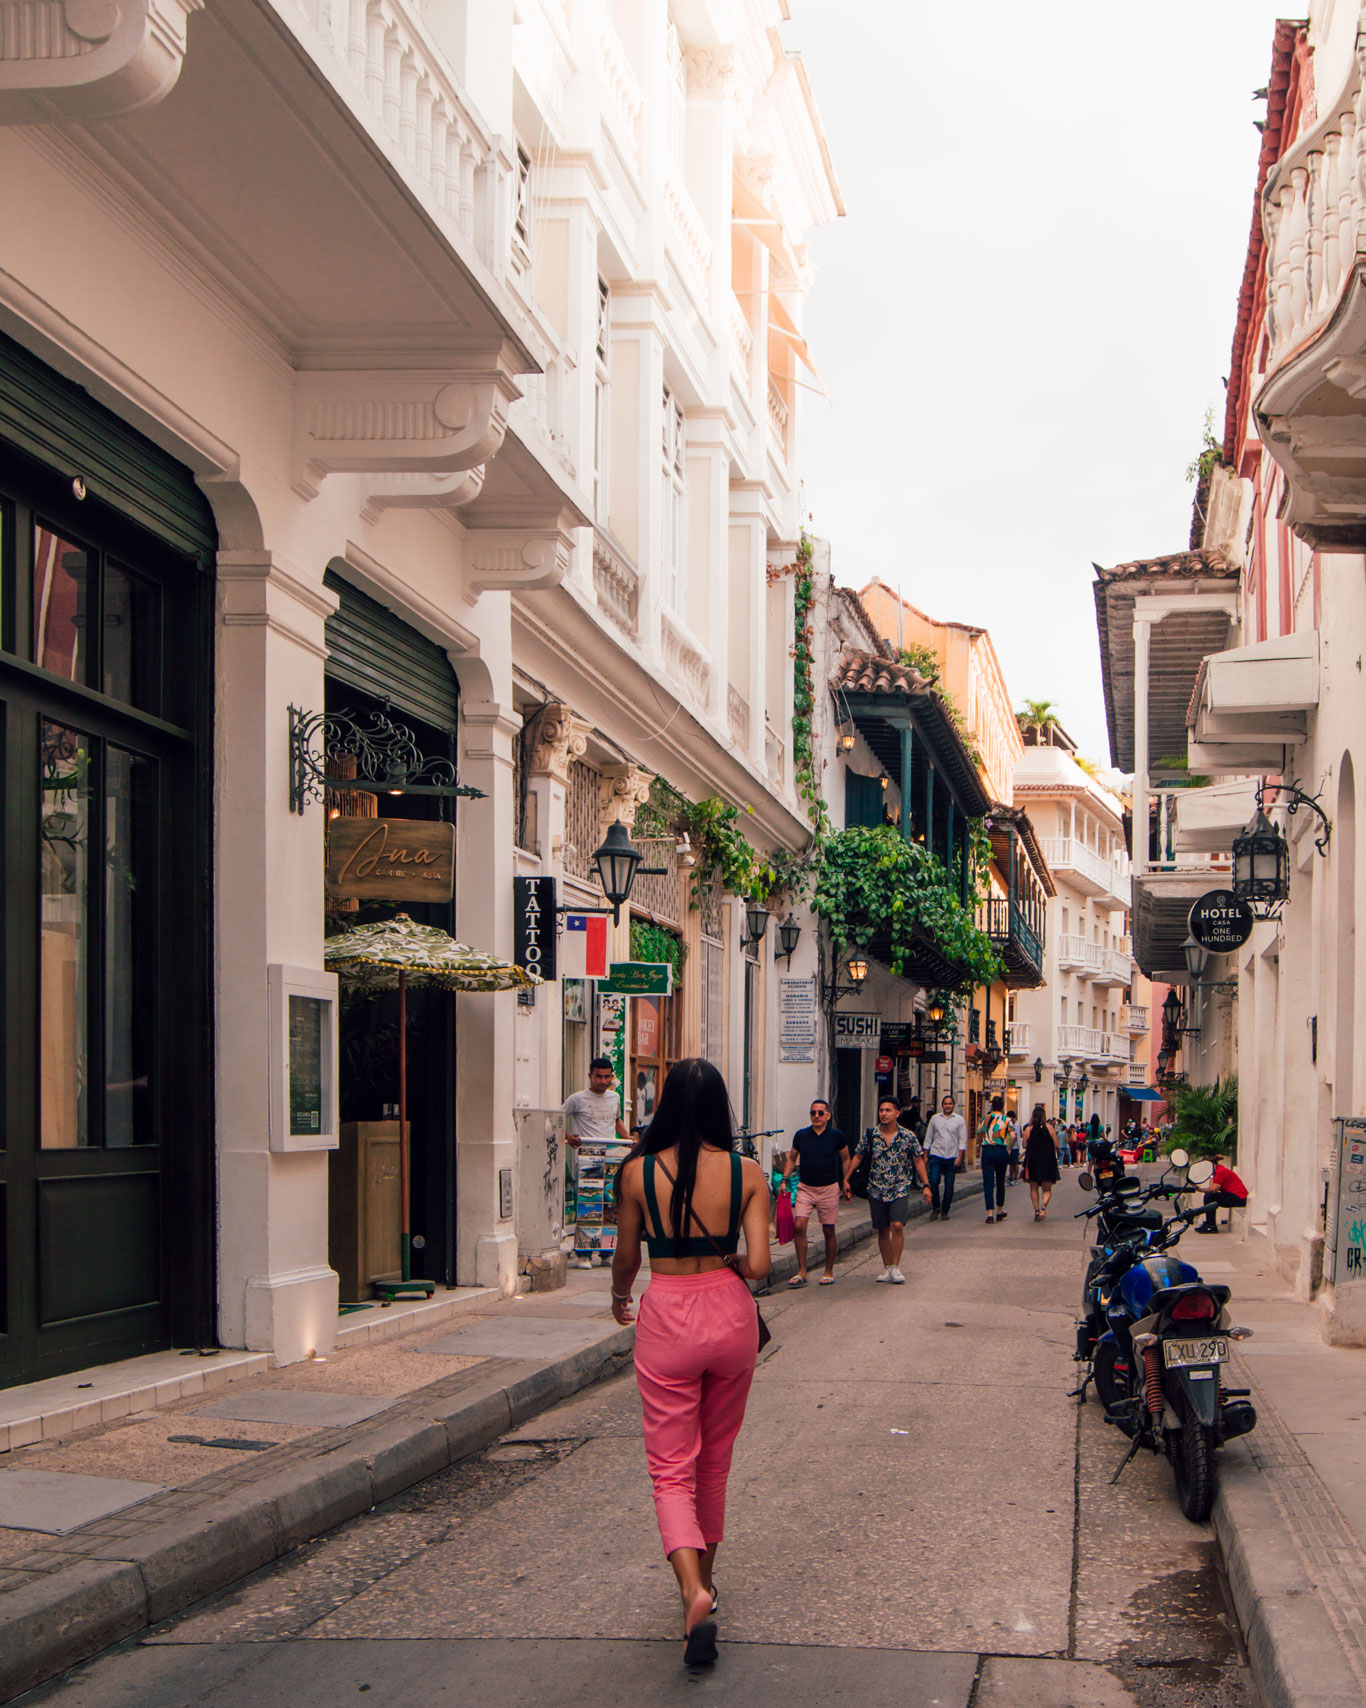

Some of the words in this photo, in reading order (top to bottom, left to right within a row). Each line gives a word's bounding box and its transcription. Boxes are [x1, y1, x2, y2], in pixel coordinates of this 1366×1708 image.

[338, 823, 441, 885] Ana
[375, 868, 406, 878] CARIBE
[422, 871, 441, 880] ASIA
[1201, 908, 1242, 919] HOTEL
[524, 879, 542, 978] TATTOO
[1201, 935, 1243, 943] HUNDRED
[837, 1017, 877, 1035] SUSHI
